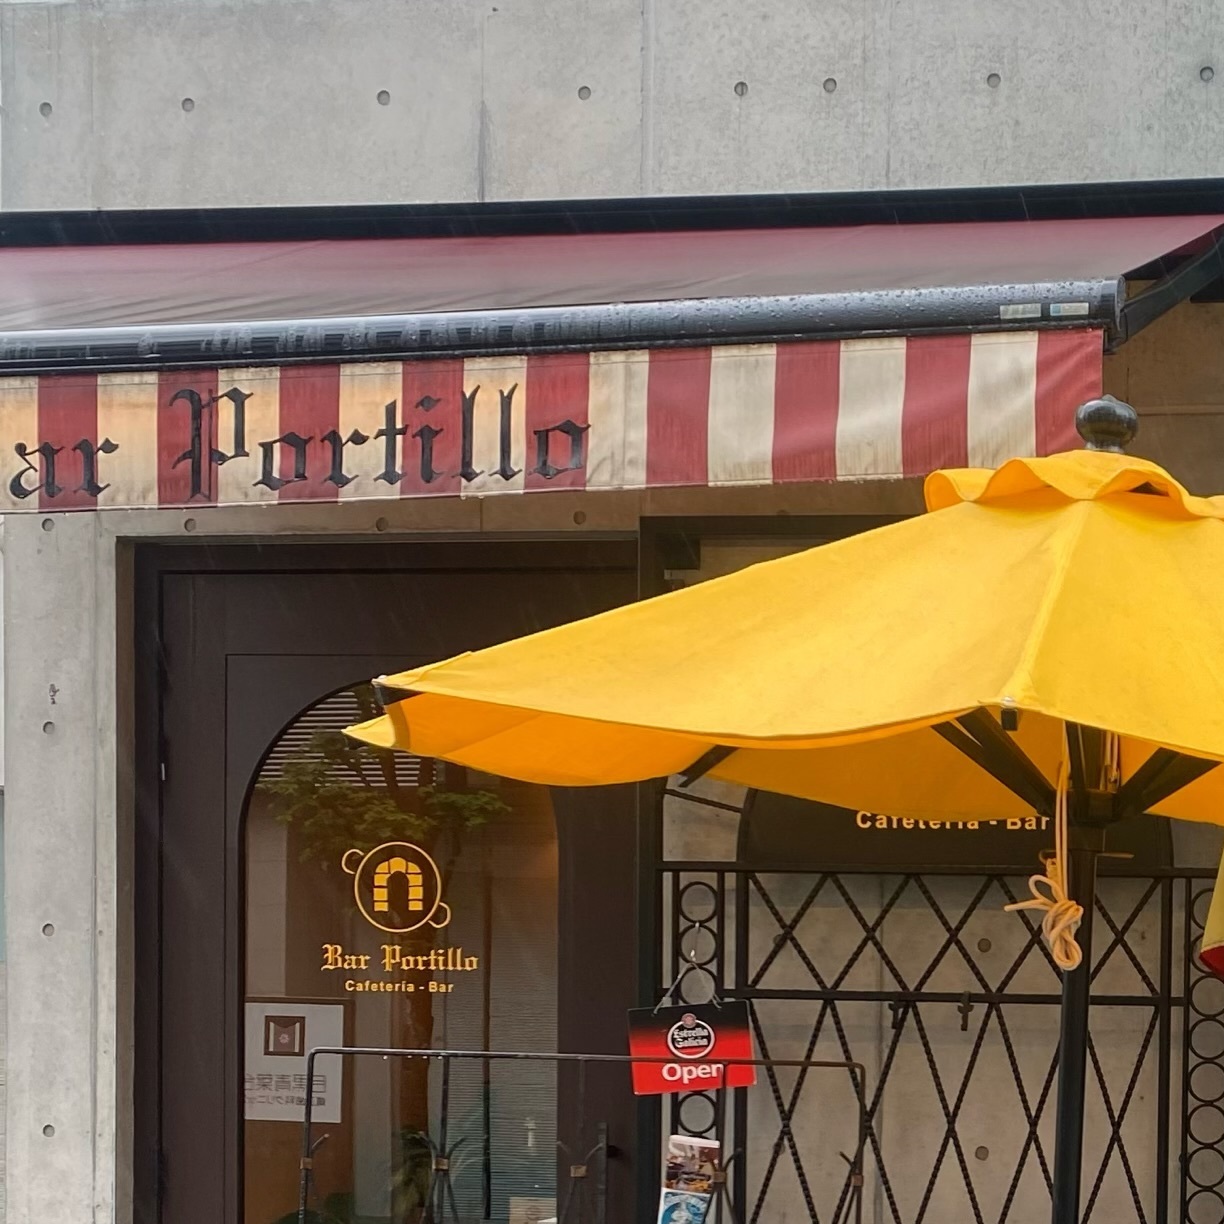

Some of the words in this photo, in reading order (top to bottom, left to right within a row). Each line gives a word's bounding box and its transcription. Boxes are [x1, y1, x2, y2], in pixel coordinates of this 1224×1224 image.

[168, 382, 591, 502] Portillo
[1007, 816, 1050, 830] Bar
[321, 943, 371, 971] Bar
[381, 944, 479, 972] Portillo
[345, 980, 415, 992] Cafeteria
[429, 981, 454, 992] Bar
[662, 1063, 724, 1084] Open
